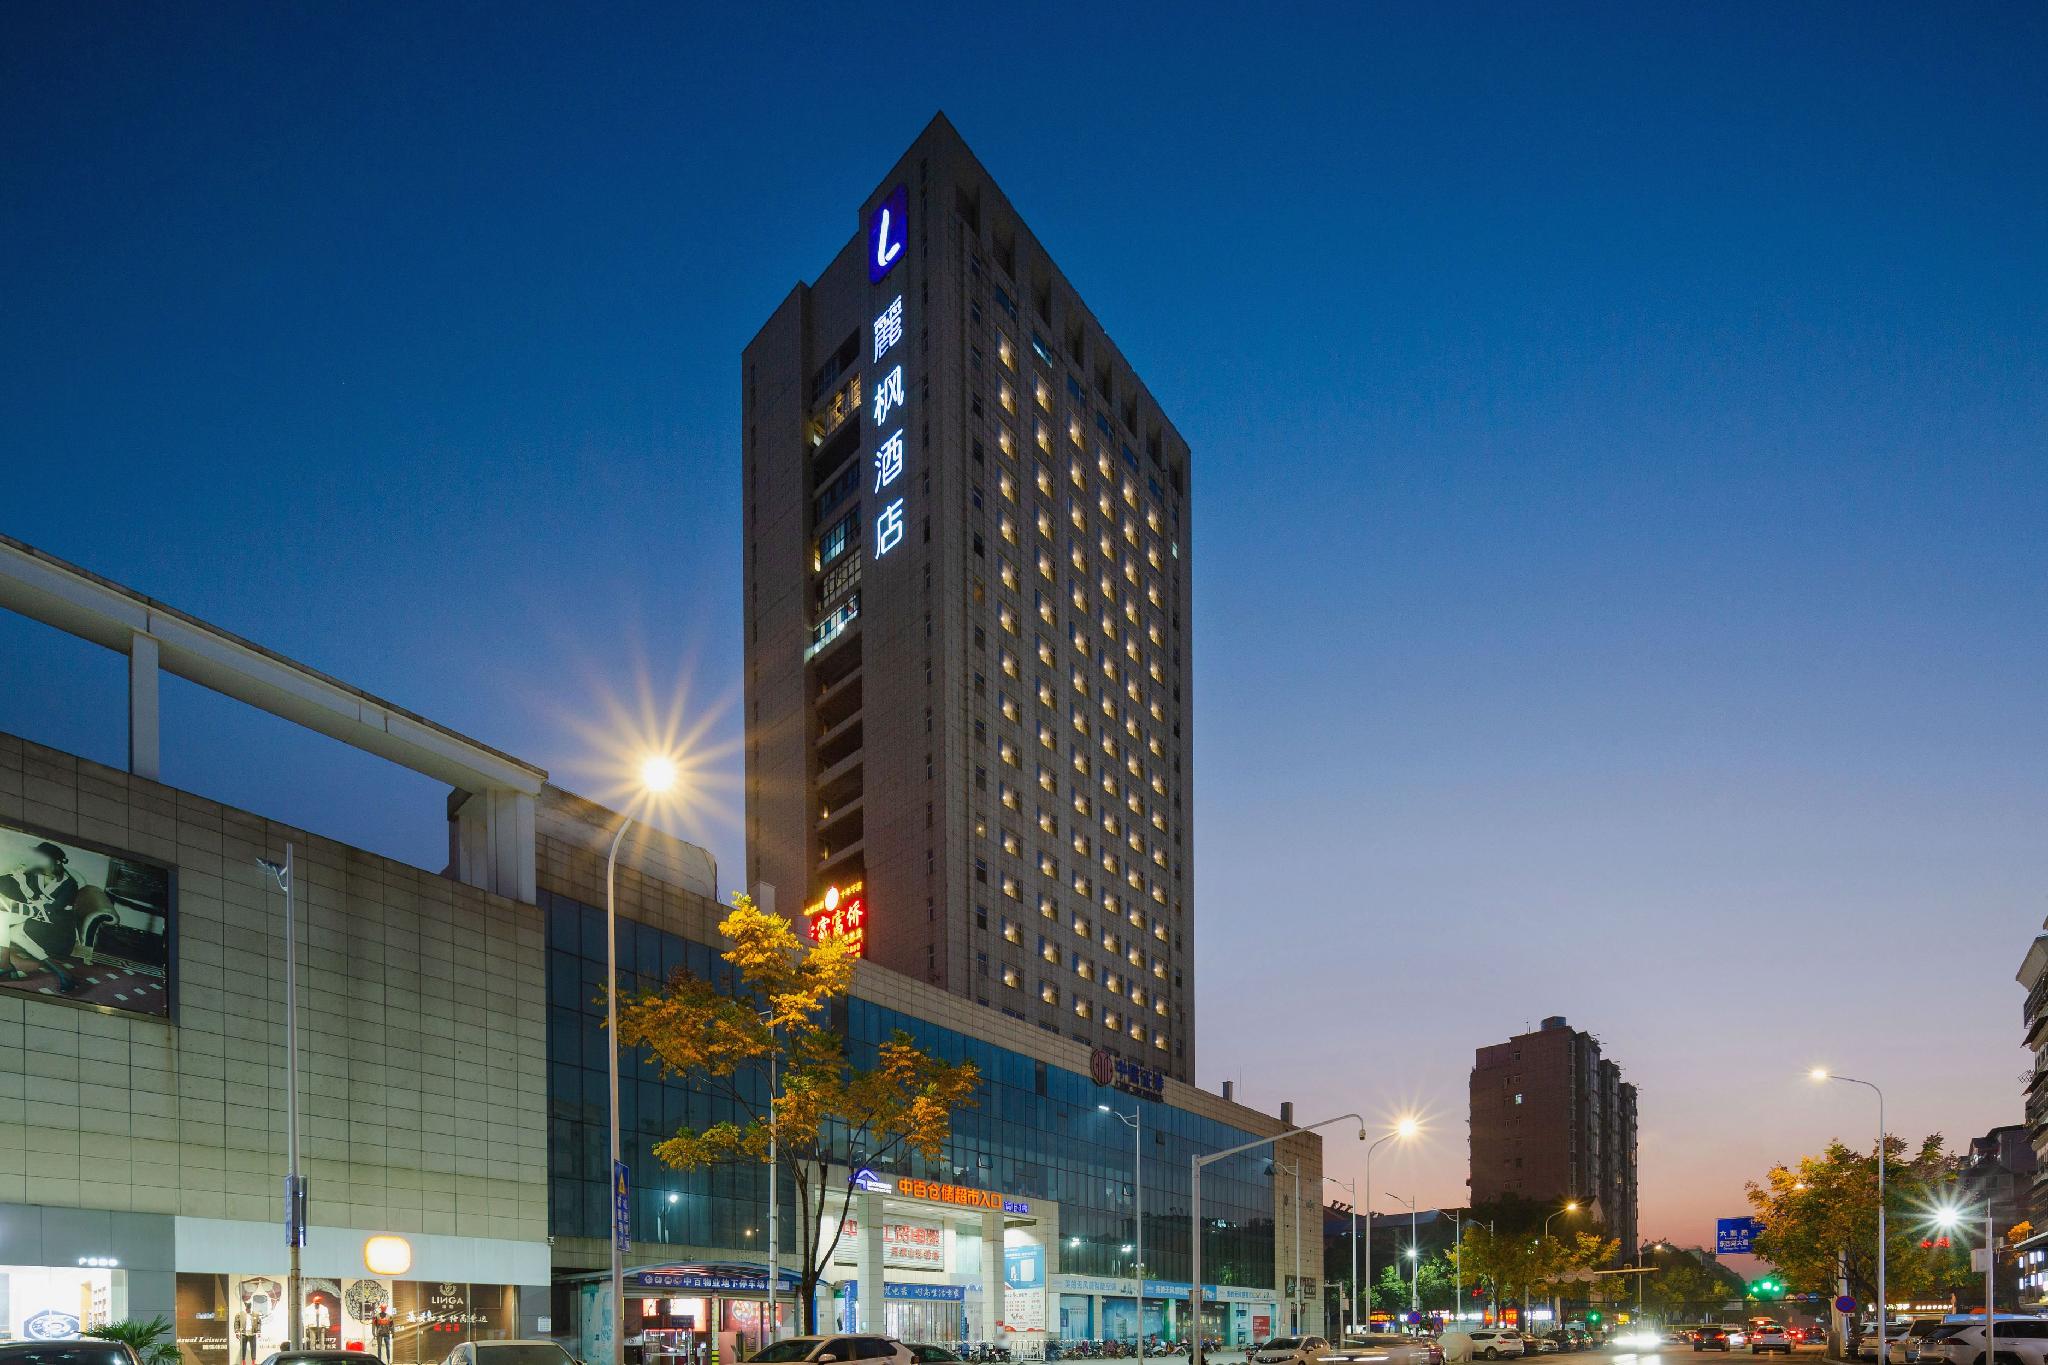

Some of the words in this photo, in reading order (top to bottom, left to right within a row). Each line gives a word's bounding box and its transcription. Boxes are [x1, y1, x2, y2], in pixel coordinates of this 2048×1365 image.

[897, 1178, 1001, 1208] 中百仓储超市入口
